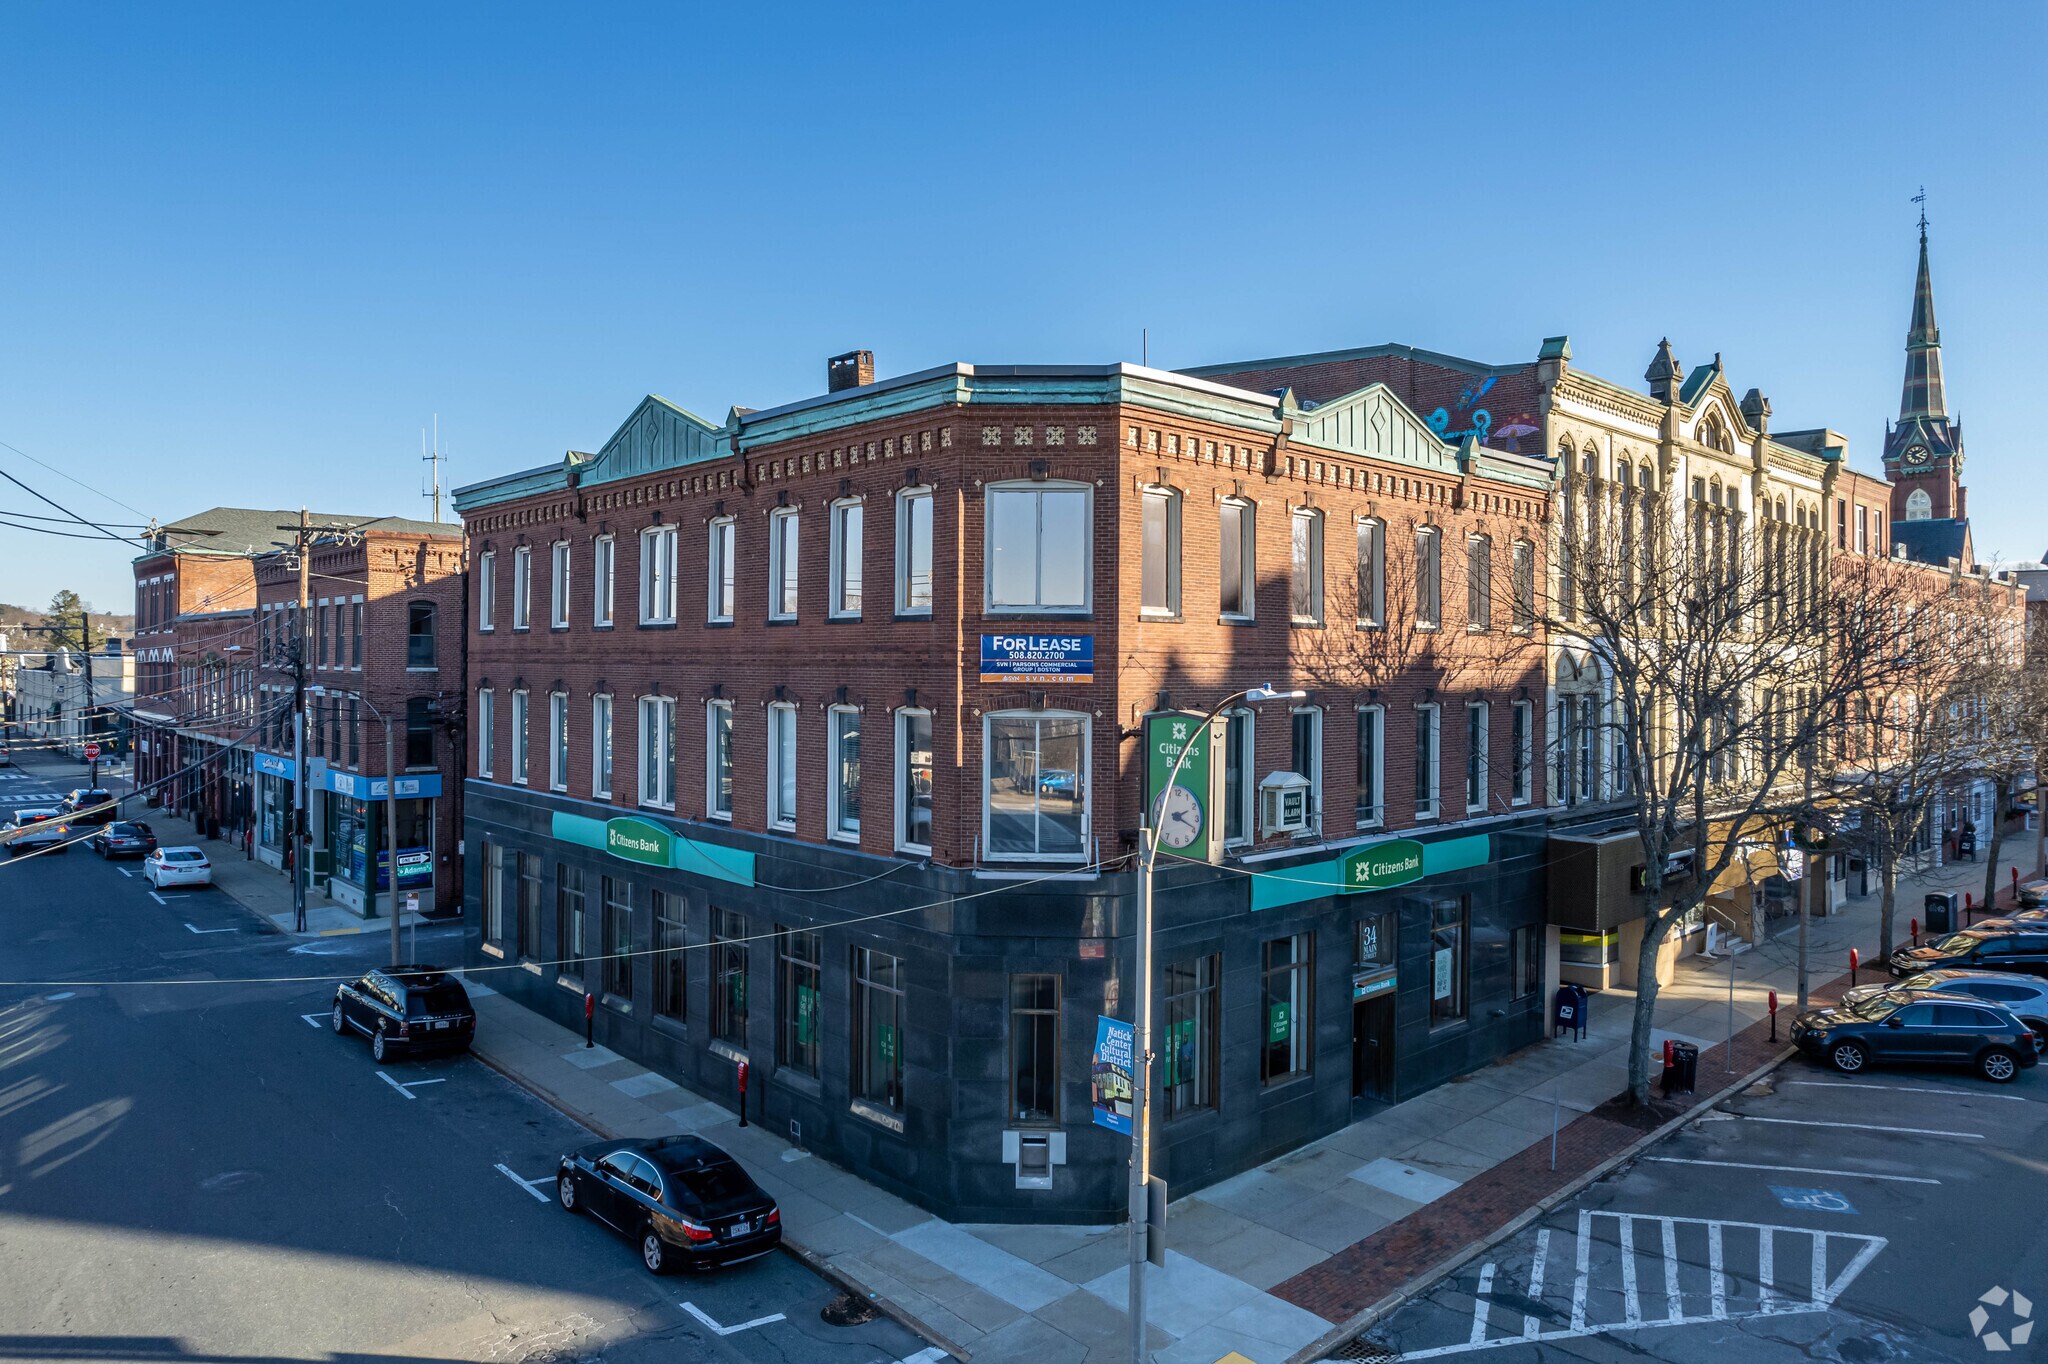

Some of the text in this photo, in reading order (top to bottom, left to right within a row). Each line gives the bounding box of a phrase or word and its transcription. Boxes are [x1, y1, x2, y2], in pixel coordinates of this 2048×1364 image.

[993, 636, 1081, 651] FOR LEASE
[1160, 743, 1199, 756] Citizns
[1175, 789, 1182, 797] 12
[1285, 797, 1300, 806] VAULT
[1285, 808, 1300, 817] ALARM
[617, 834, 659, 853] Citizens Bank
[1373, 855, 1419, 876] Citizens Bank
[1364, 925, 1377, 946] 34
[1364, 943, 1377, 953] MAIN
[1108, 1027, 1132, 1041] Natick
[1107, 1036, 1131, 1050] Center
[1100, 1043, 1131, 1059] Cultural
[1101, 1052, 1131, 1068] District
